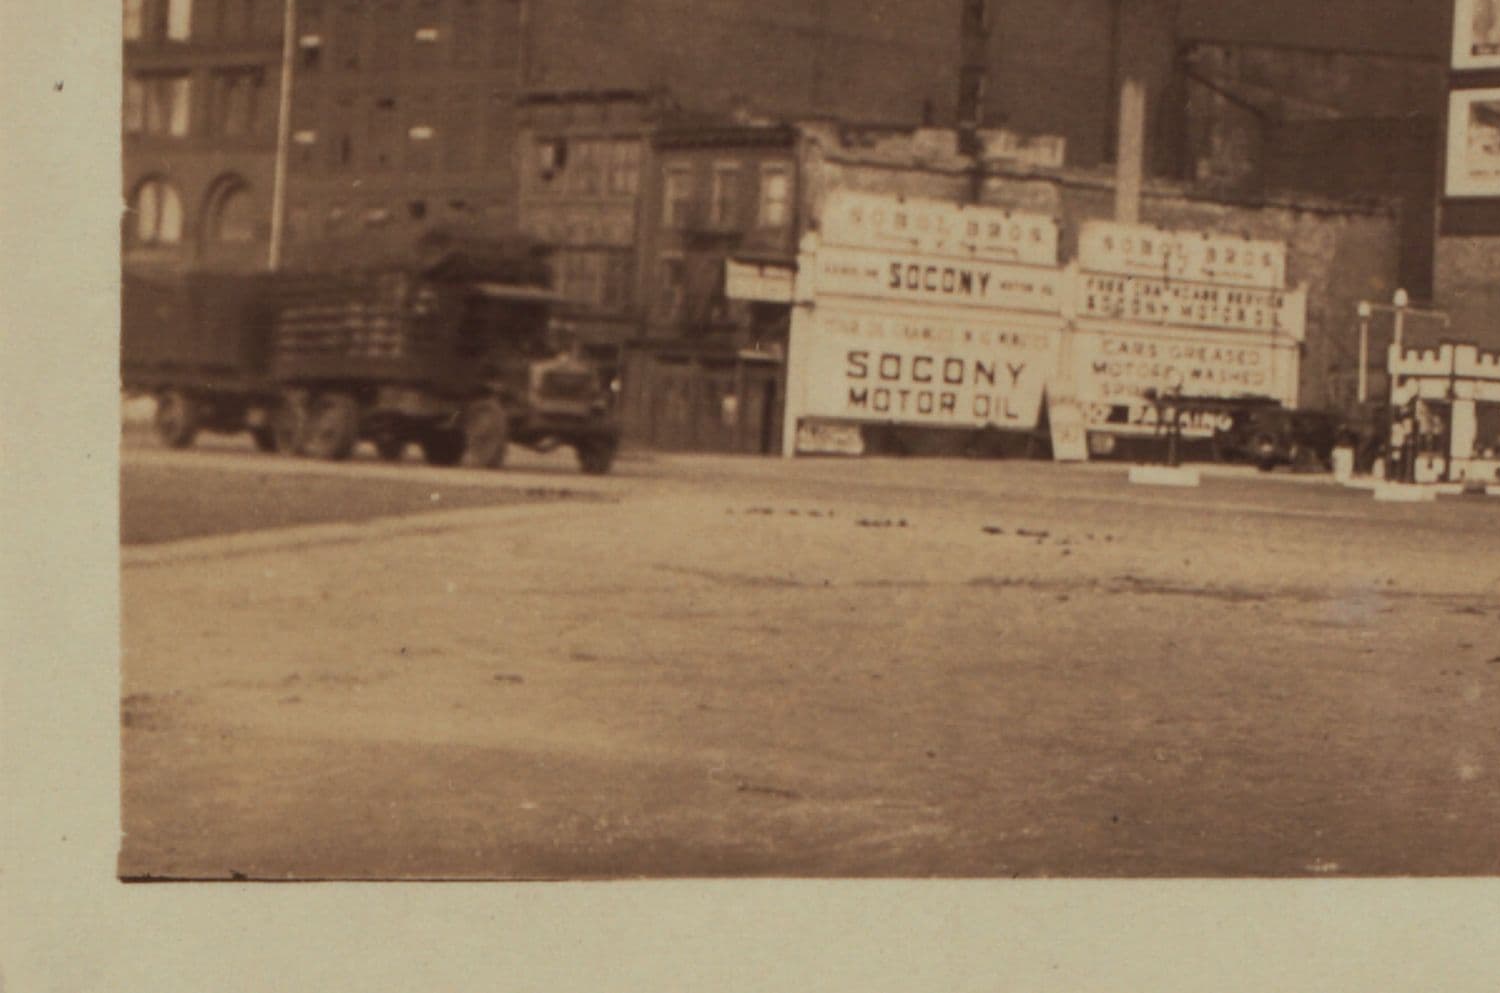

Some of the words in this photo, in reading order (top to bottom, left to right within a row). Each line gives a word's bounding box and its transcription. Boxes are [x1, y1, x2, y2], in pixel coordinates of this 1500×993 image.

[888, 262, 991, 296] SOCONY
[846, 349, 1026, 387] SOCONY
[849, 387, 956, 415] MOTOR
[973, 394, 1020, 419] OIL
